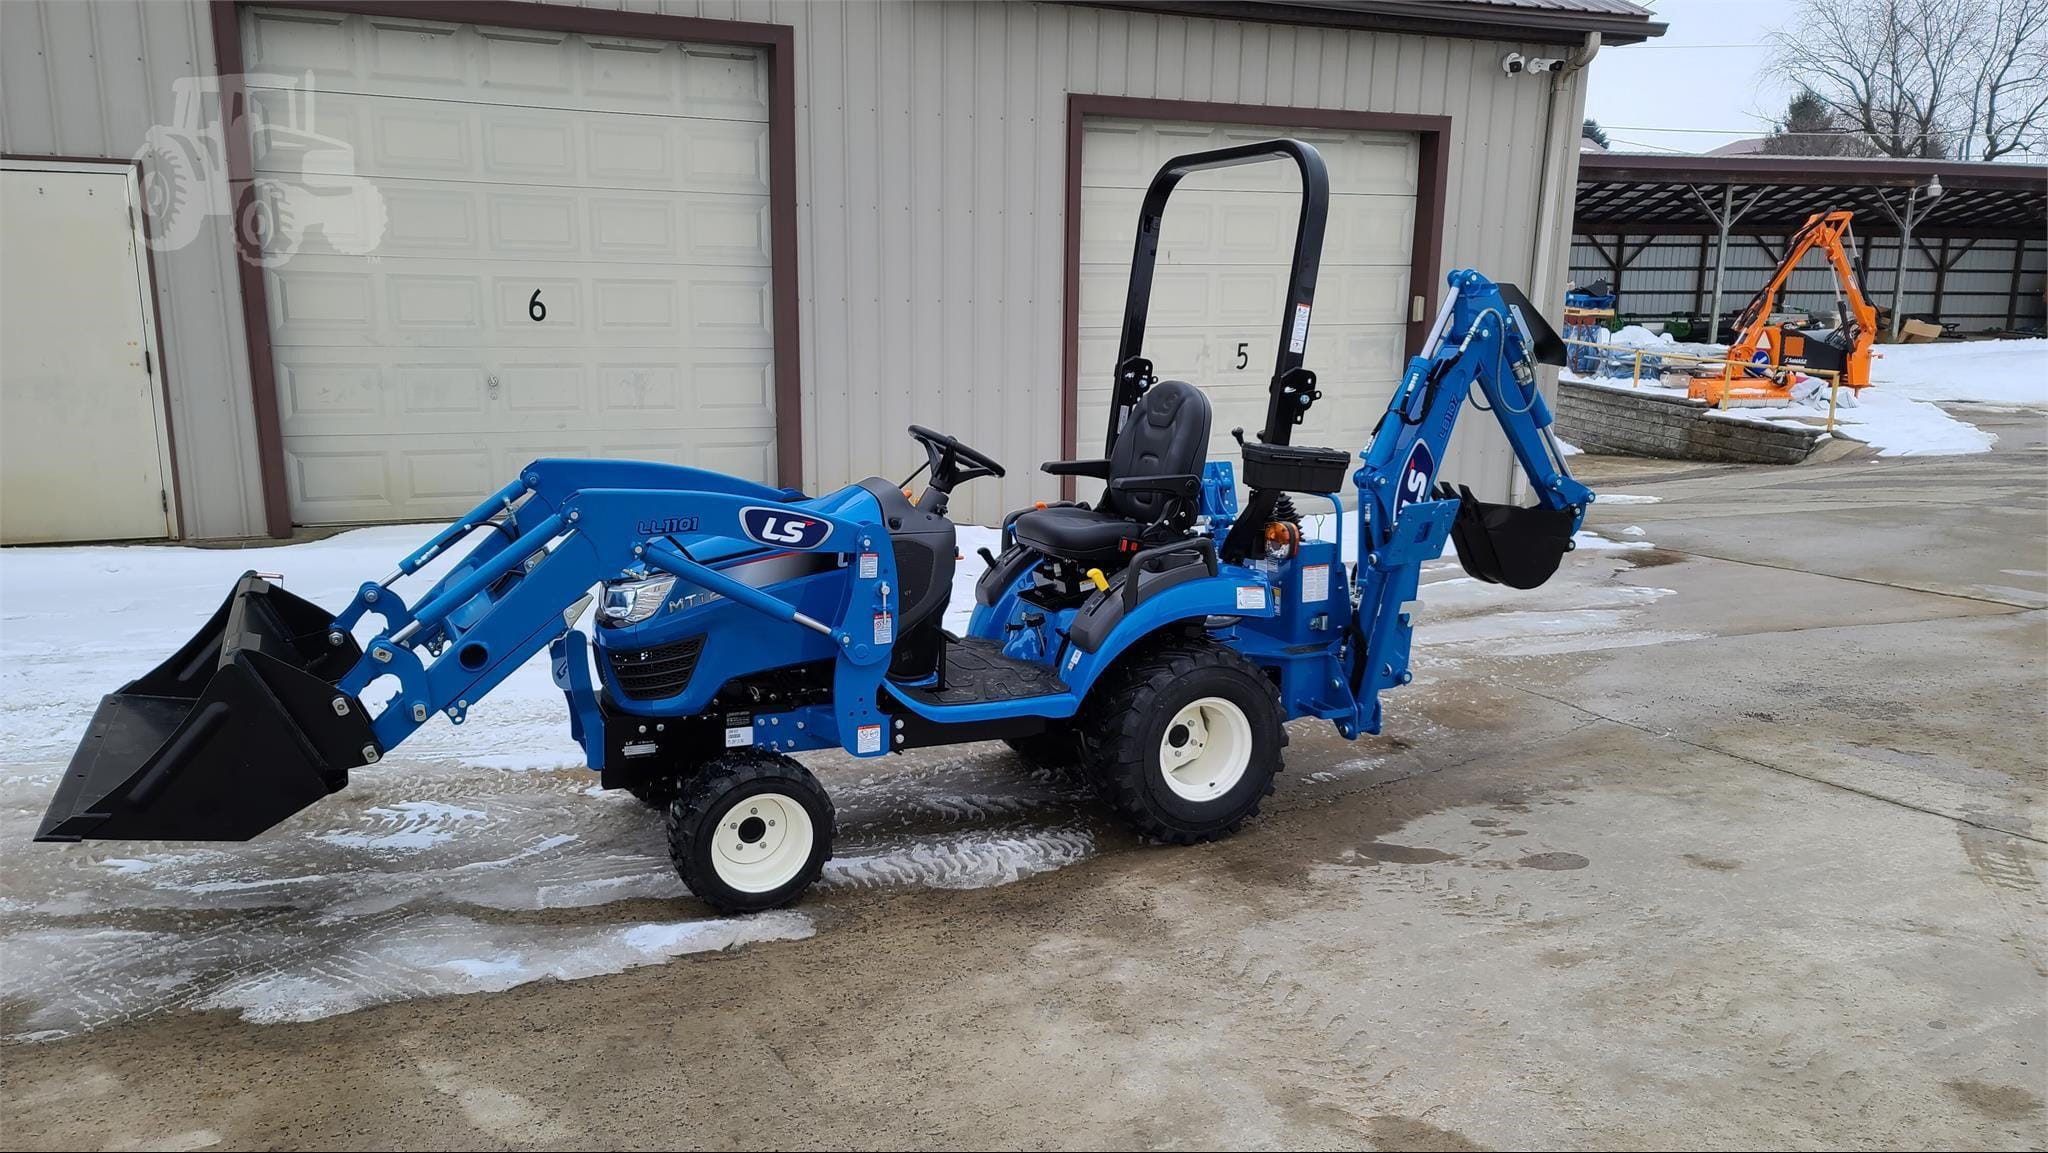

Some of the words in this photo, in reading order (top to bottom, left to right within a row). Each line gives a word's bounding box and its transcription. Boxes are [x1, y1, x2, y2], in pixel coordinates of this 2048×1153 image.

[529, 288, 546, 322] 6
[1236, 342, 1248, 370] 5
[638, 516, 699, 535] LL1101
[761, 517, 807, 544] LS
